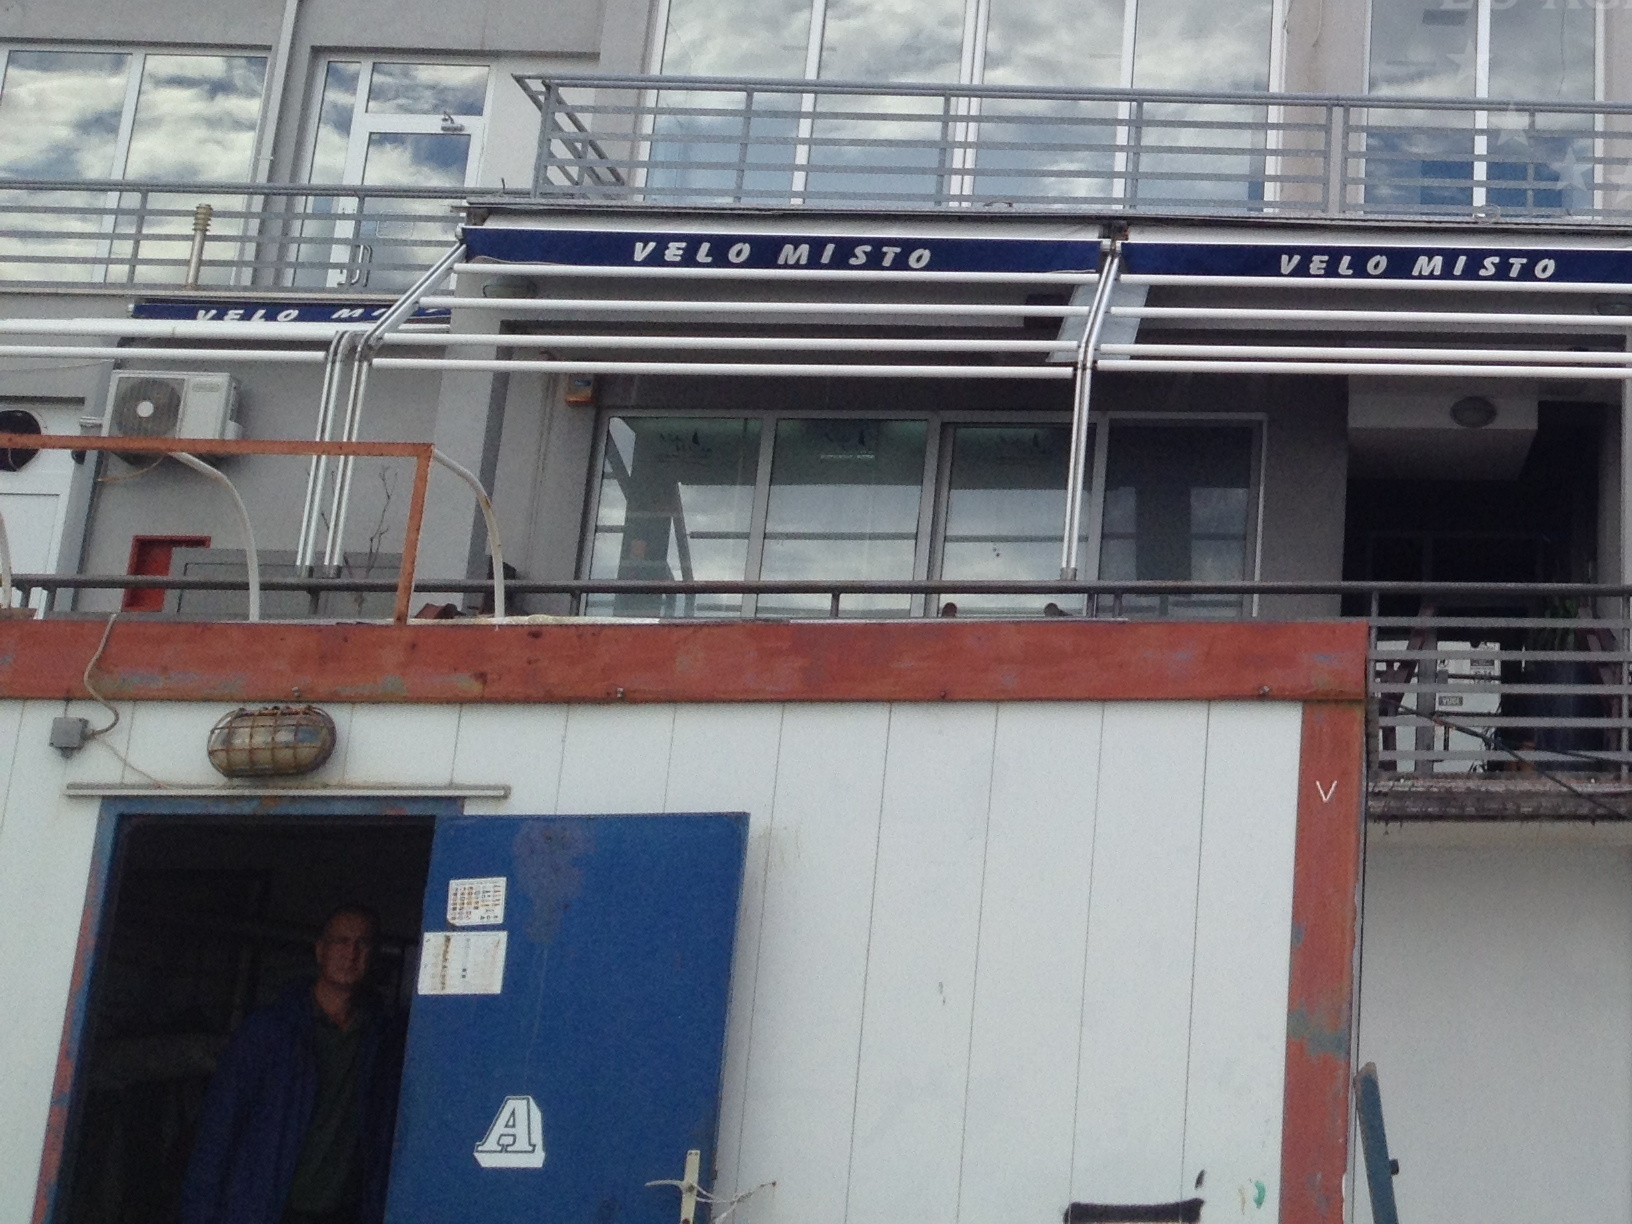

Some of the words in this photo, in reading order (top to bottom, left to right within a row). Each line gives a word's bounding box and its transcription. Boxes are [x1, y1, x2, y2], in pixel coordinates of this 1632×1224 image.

[633, 242, 750, 263] VELO
[777, 244, 931, 268] MISTO
[1280, 254, 1388, 275] VELO
[1412, 255, 1556, 279] MISTO
[196, 309, 299, 322] VELO
